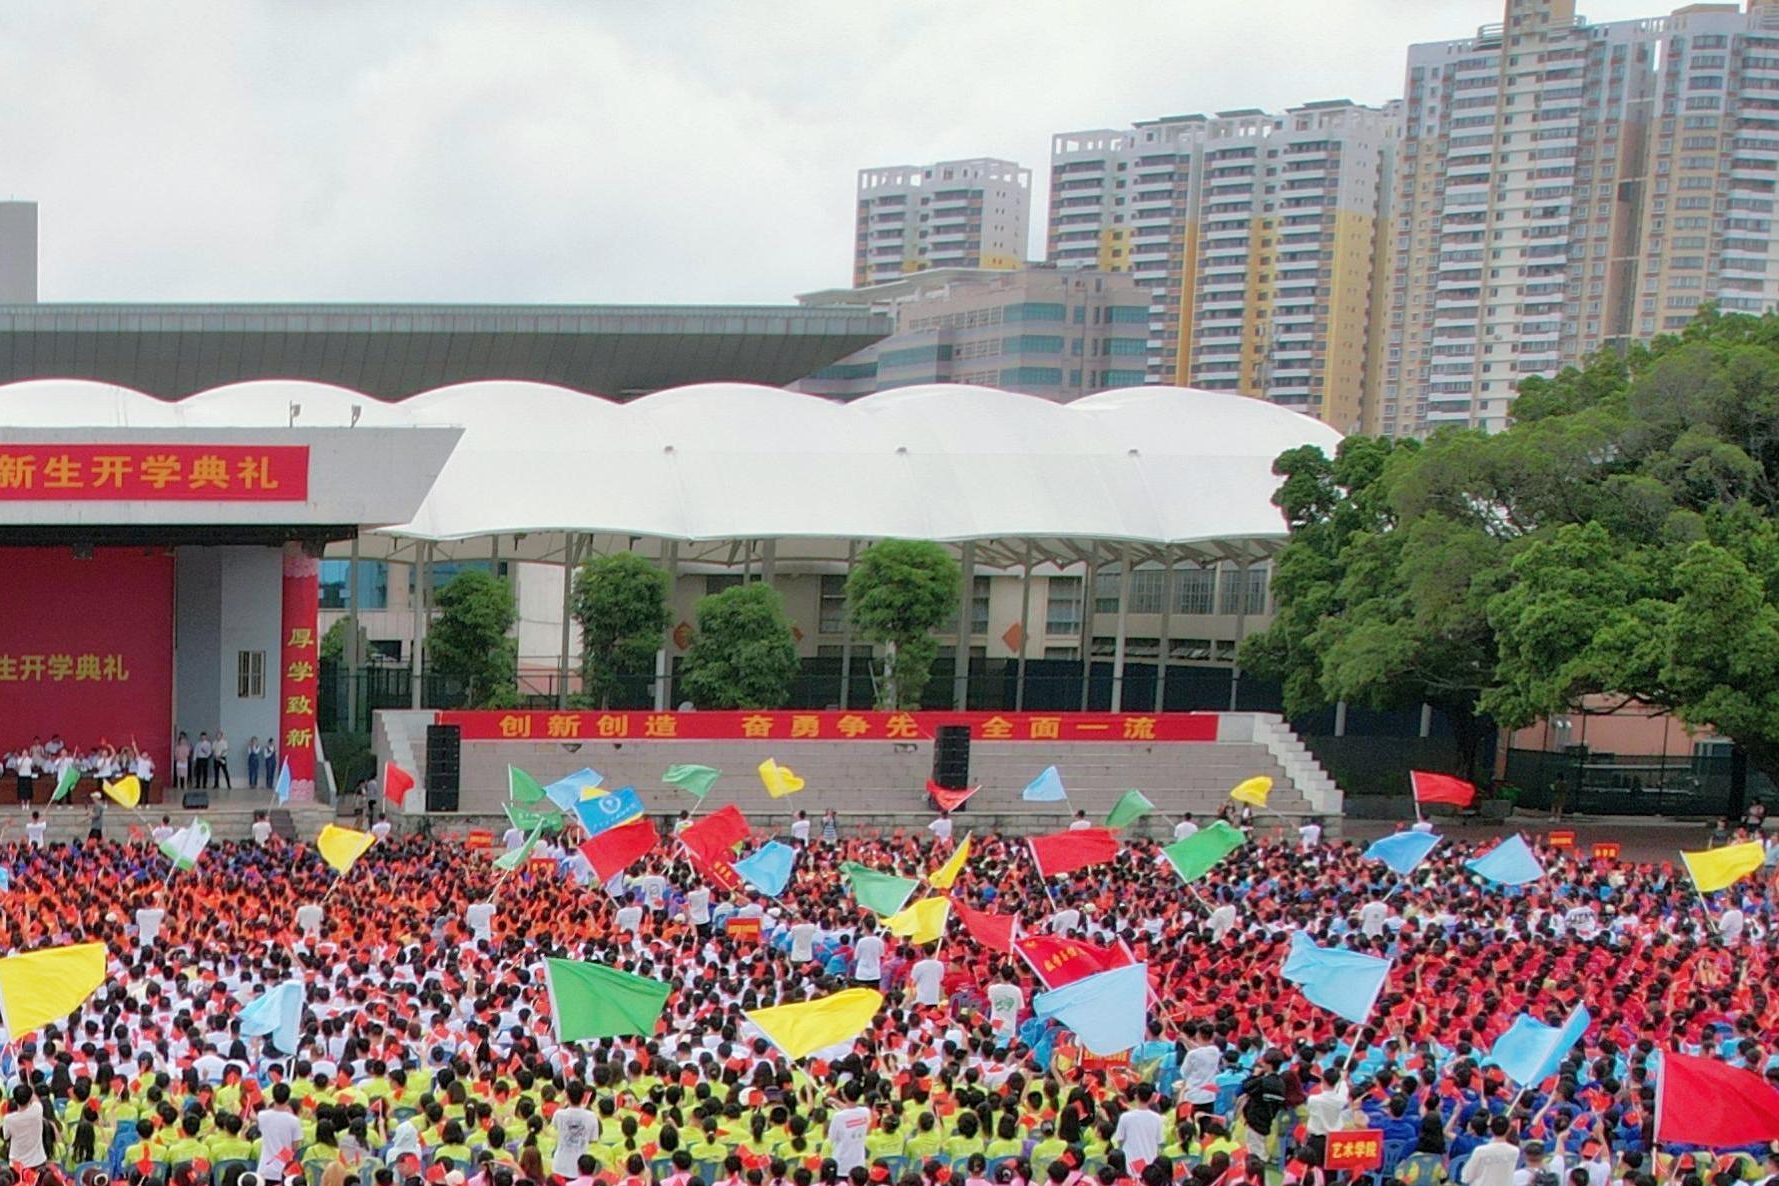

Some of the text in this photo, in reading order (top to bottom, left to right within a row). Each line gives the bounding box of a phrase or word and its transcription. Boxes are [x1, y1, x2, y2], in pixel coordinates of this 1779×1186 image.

[285, 628, 315, 748] 厚学致新
[499, 713, 1157, 740] 创新创造 奋勇争先 全面一流
[1331, 1141, 1378, 1158] 艺术学院
